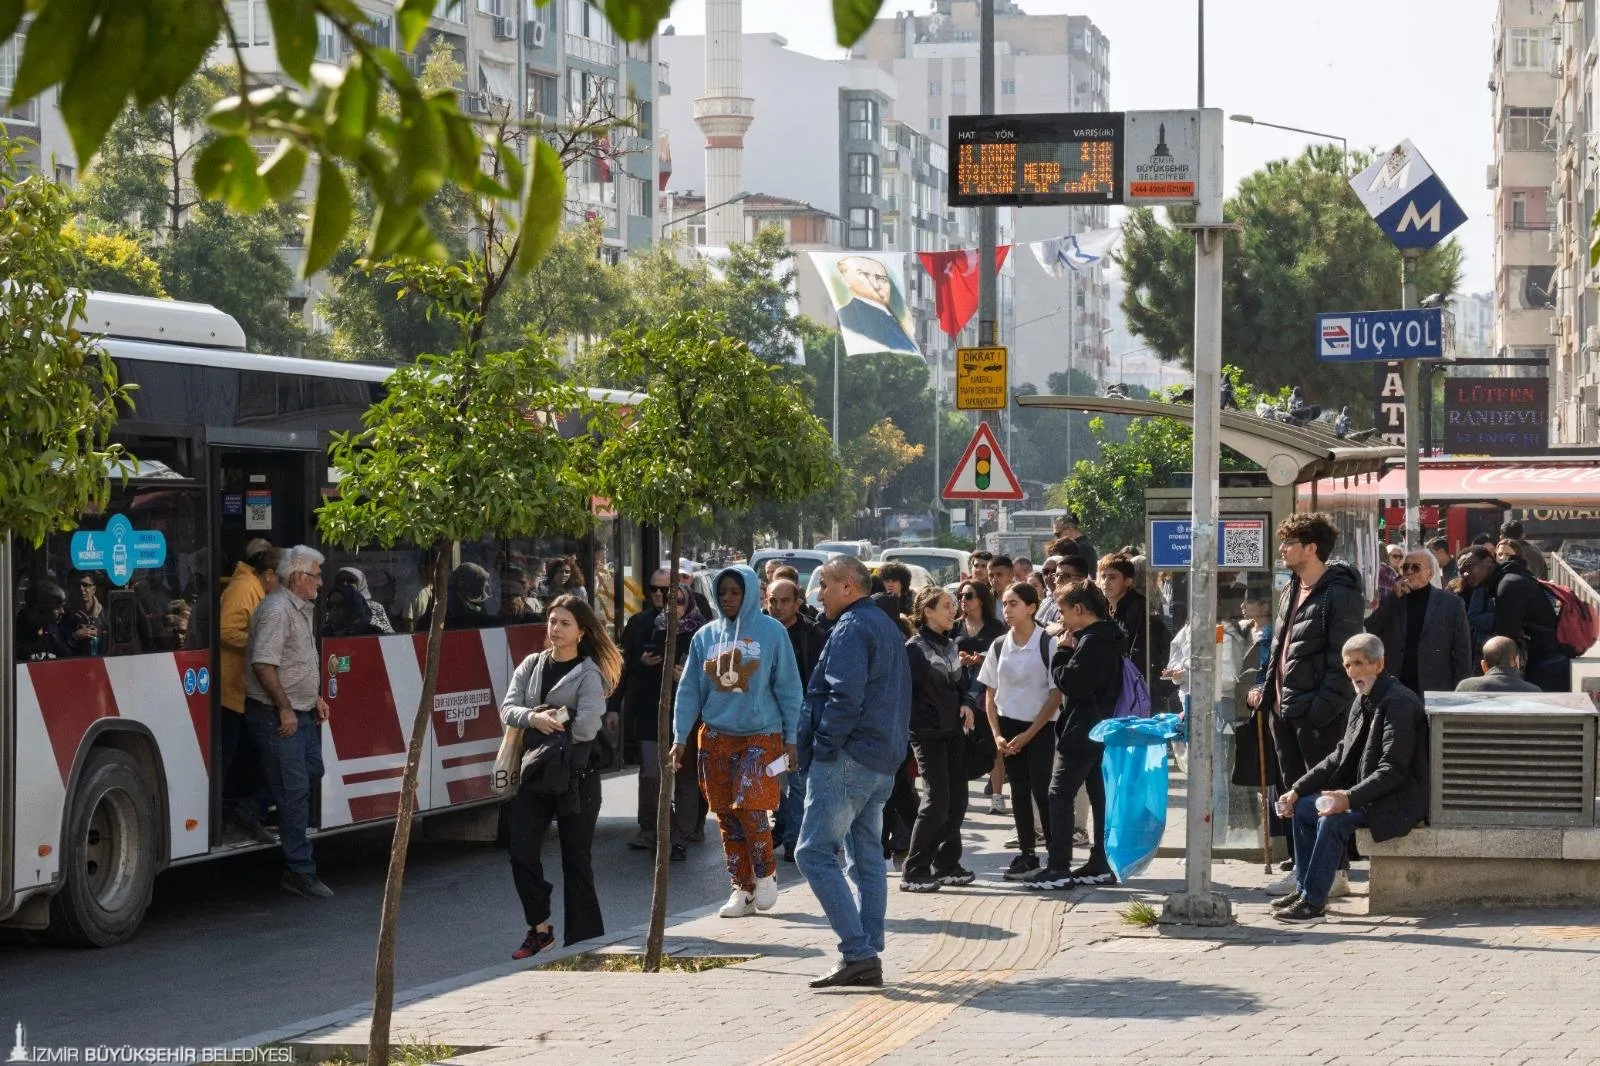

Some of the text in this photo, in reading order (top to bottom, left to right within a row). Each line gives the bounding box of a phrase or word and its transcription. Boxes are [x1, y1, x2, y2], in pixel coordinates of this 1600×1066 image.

[958, 131, 976, 139] HAT
[995, 128, 1014, 138] YÖN
[1023, 163, 1060, 173] METRO
[1023, 173, 1060, 183] METRO
[1396, 200, 1441, 233] M
[1355, 317, 1437, 355] ÜÇYOL
[447, 705, 478, 720] ESHOT
